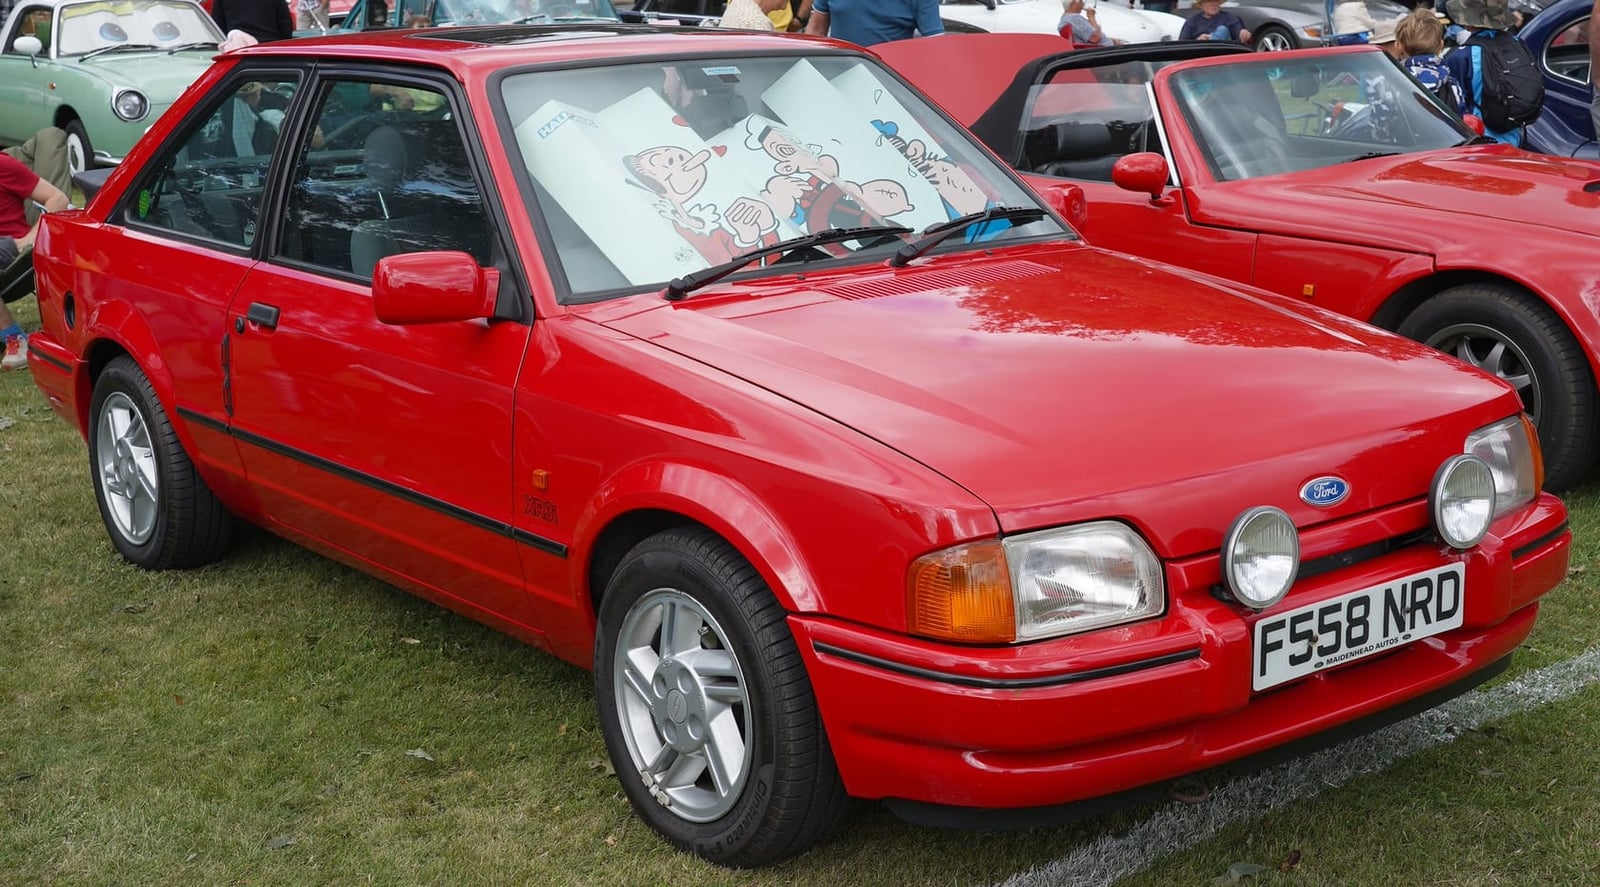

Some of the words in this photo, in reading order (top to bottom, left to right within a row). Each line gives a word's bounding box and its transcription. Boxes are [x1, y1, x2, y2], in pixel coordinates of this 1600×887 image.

[1313, 481, 1338, 499] Ford
[1260, 594, 1371, 678] F558
[1383, 570, 1460, 638] NRD
[1326, 645, 1374, 665] MAIDENHEAD
[1375, 636, 1399, 650] AUTOS
